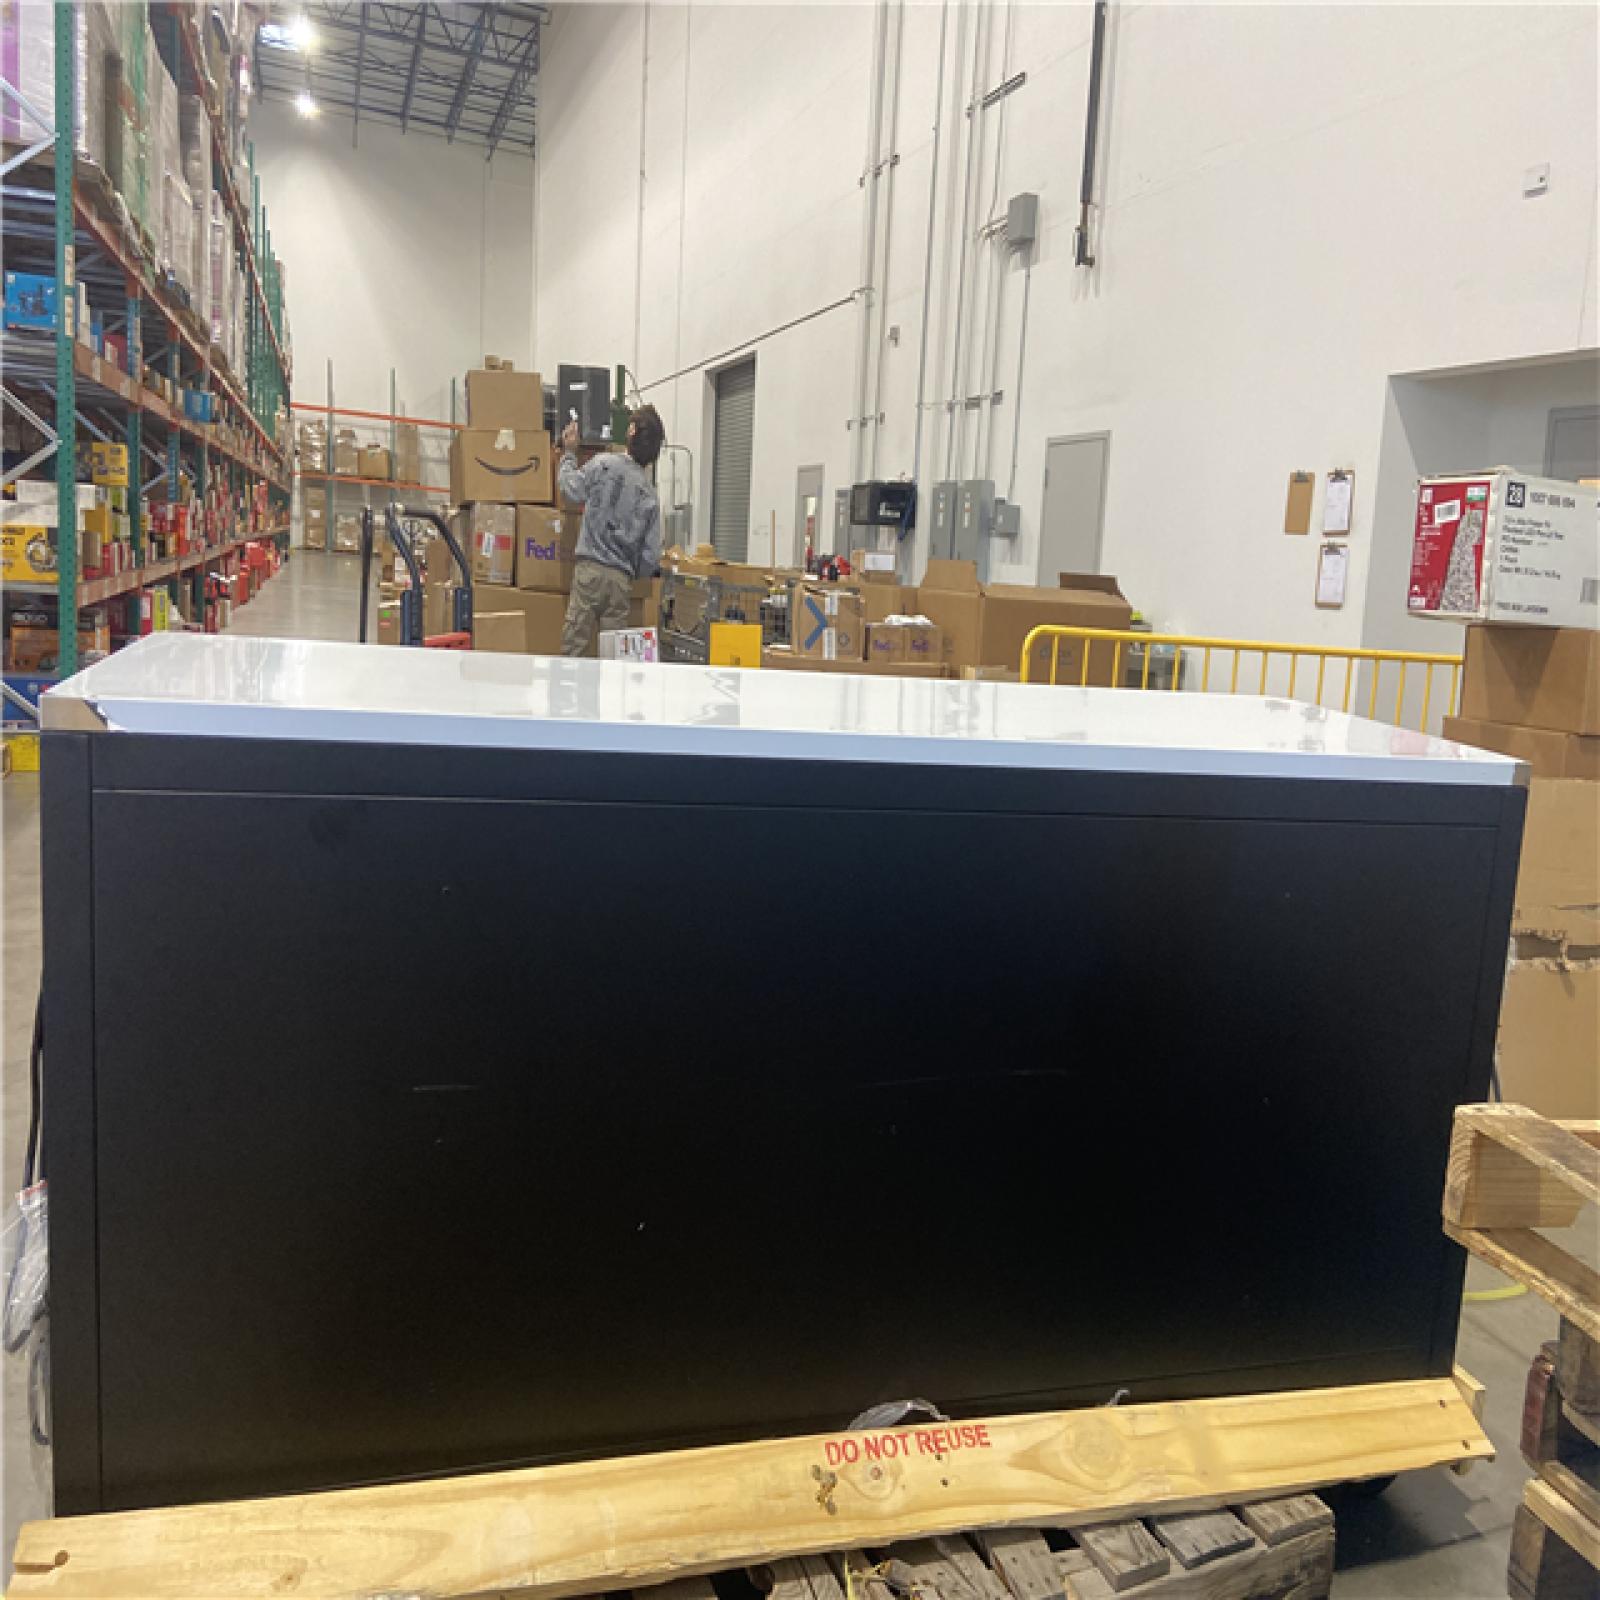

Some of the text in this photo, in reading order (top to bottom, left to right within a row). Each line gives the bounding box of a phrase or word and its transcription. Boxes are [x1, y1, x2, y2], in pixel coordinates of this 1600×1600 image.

[525, 536, 560, 561] Fed
[824, 1424, 991, 1465] DO NOT REUSE
